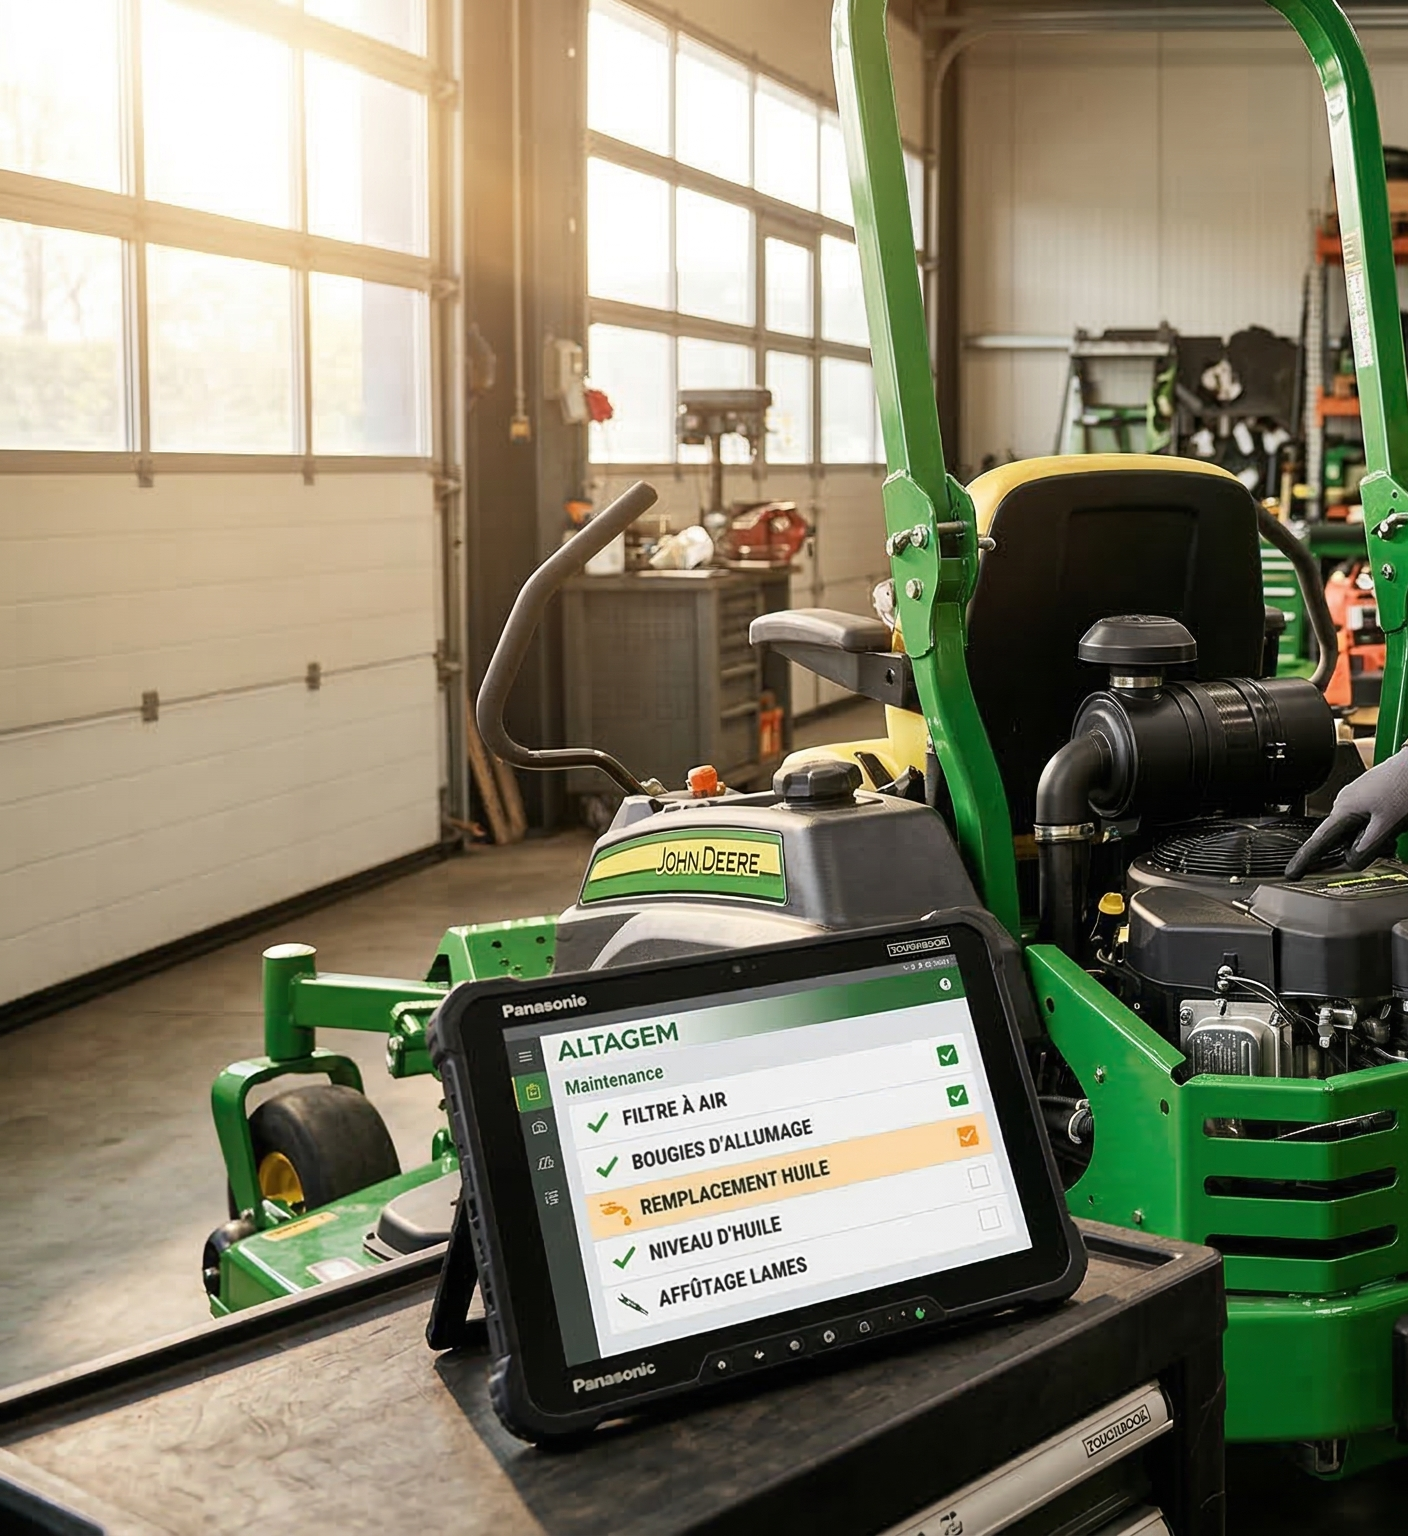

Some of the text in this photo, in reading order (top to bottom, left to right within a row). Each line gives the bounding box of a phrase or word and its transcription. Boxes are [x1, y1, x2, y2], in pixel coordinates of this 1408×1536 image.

[657, 846, 761, 874] JOHN DEERE
[502, 994, 588, 1018] Panasonic
[558, 1022, 679, 1062] ALTAGEM
[565, 1067, 664, 1096] Maintenance
[622, 1091, 728, 1126] FILTRE À AIR
[631, 1118, 813, 1170] BOUGIES D'ALLUMAGE
[640, 1159, 831, 1215] REMPLACEMENT HUILE
[648, 1215, 782, 1261] NIVEAU D'HUILE
[659, 1256, 808, 1308] AFFÛTAGE LAMES
[572, 1362, 657, 1394] Panasonic
